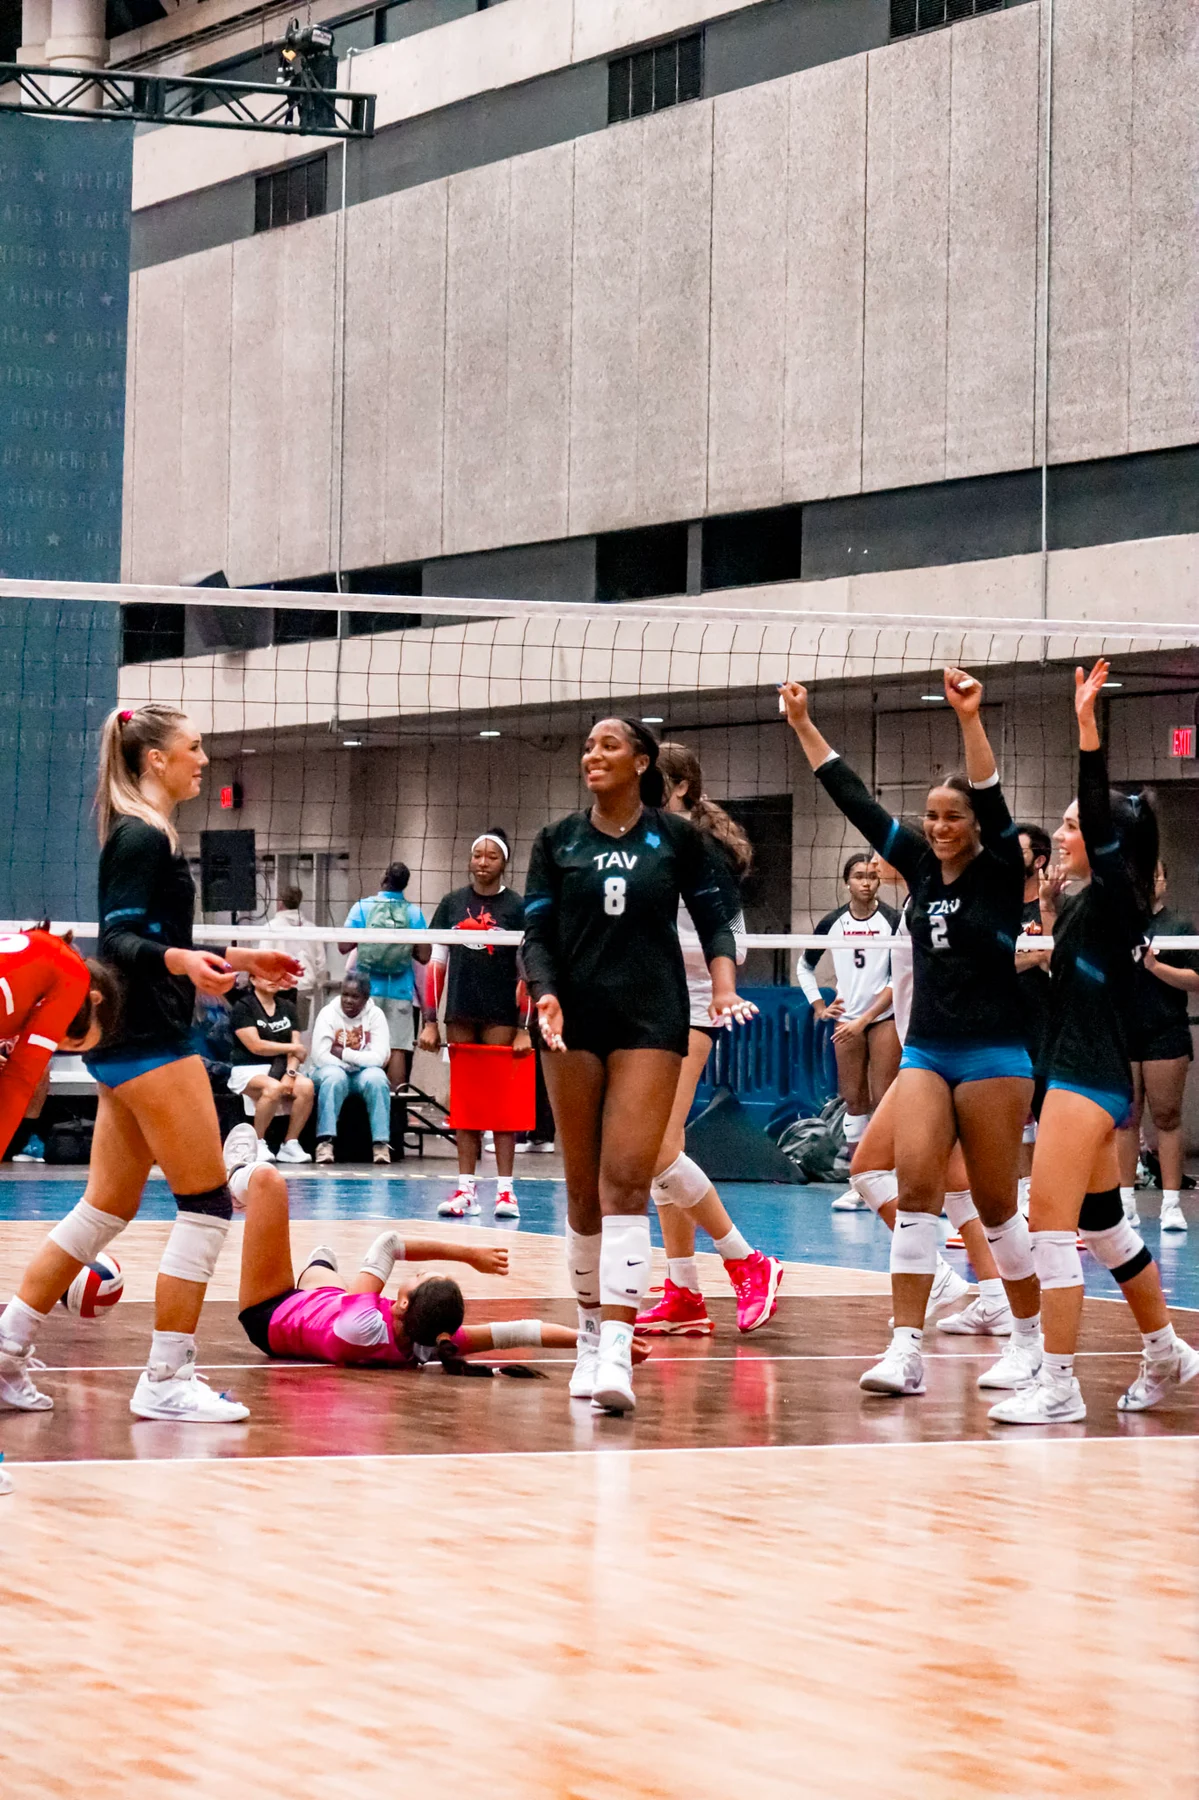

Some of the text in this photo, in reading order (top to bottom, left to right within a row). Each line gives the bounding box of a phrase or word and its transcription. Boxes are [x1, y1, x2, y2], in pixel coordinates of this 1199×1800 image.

[1173, 730, 1191, 756] EXIT
[593, 851, 638, 870] TAV
[604, 877, 626, 915] 8
[927, 898, 961, 915] TAV
[929, 914, 951, 948] 2
[854, 948, 865, 968] 5
